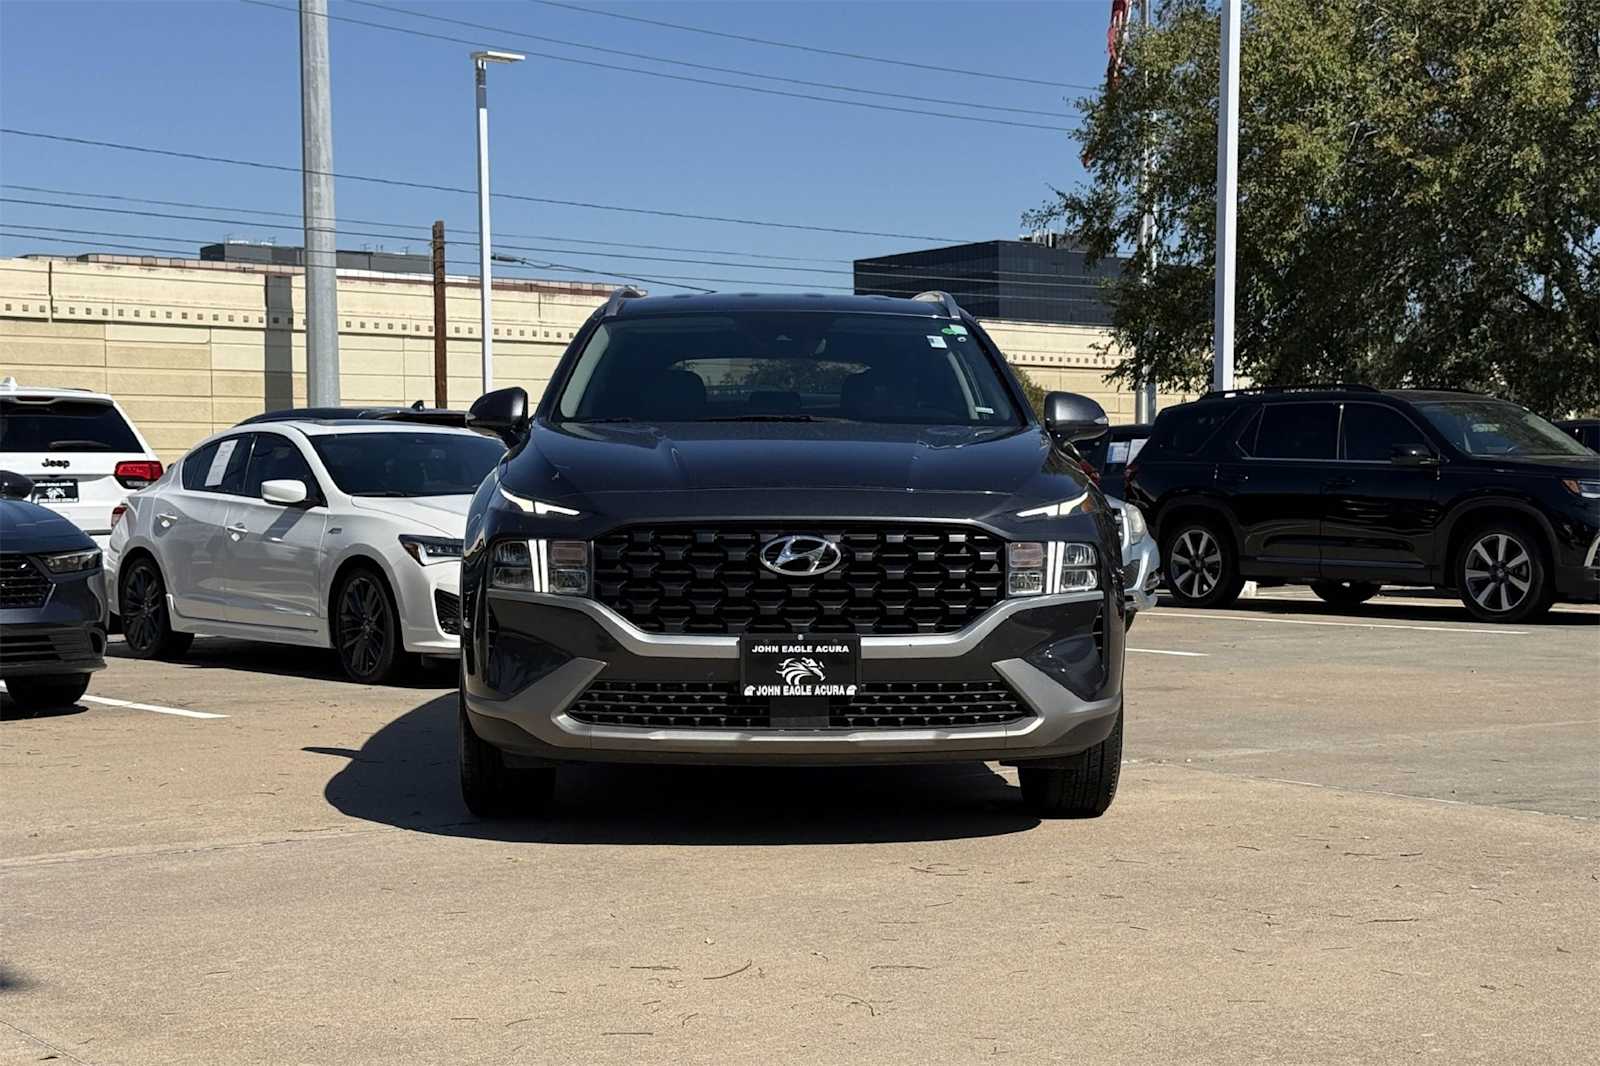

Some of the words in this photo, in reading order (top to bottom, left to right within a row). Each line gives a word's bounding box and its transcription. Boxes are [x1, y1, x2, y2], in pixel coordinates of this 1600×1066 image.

[41, 458, 71, 469] Jeep
[752, 645, 779, 653] JOHN
[781, 645, 813, 653] EAGLE
[815, 645, 850, 653] ACURA
[756, 685, 781, 696] JOHN
[782, 685, 812, 696] EAGLE
[814, 685, 845, 696] ACURA
